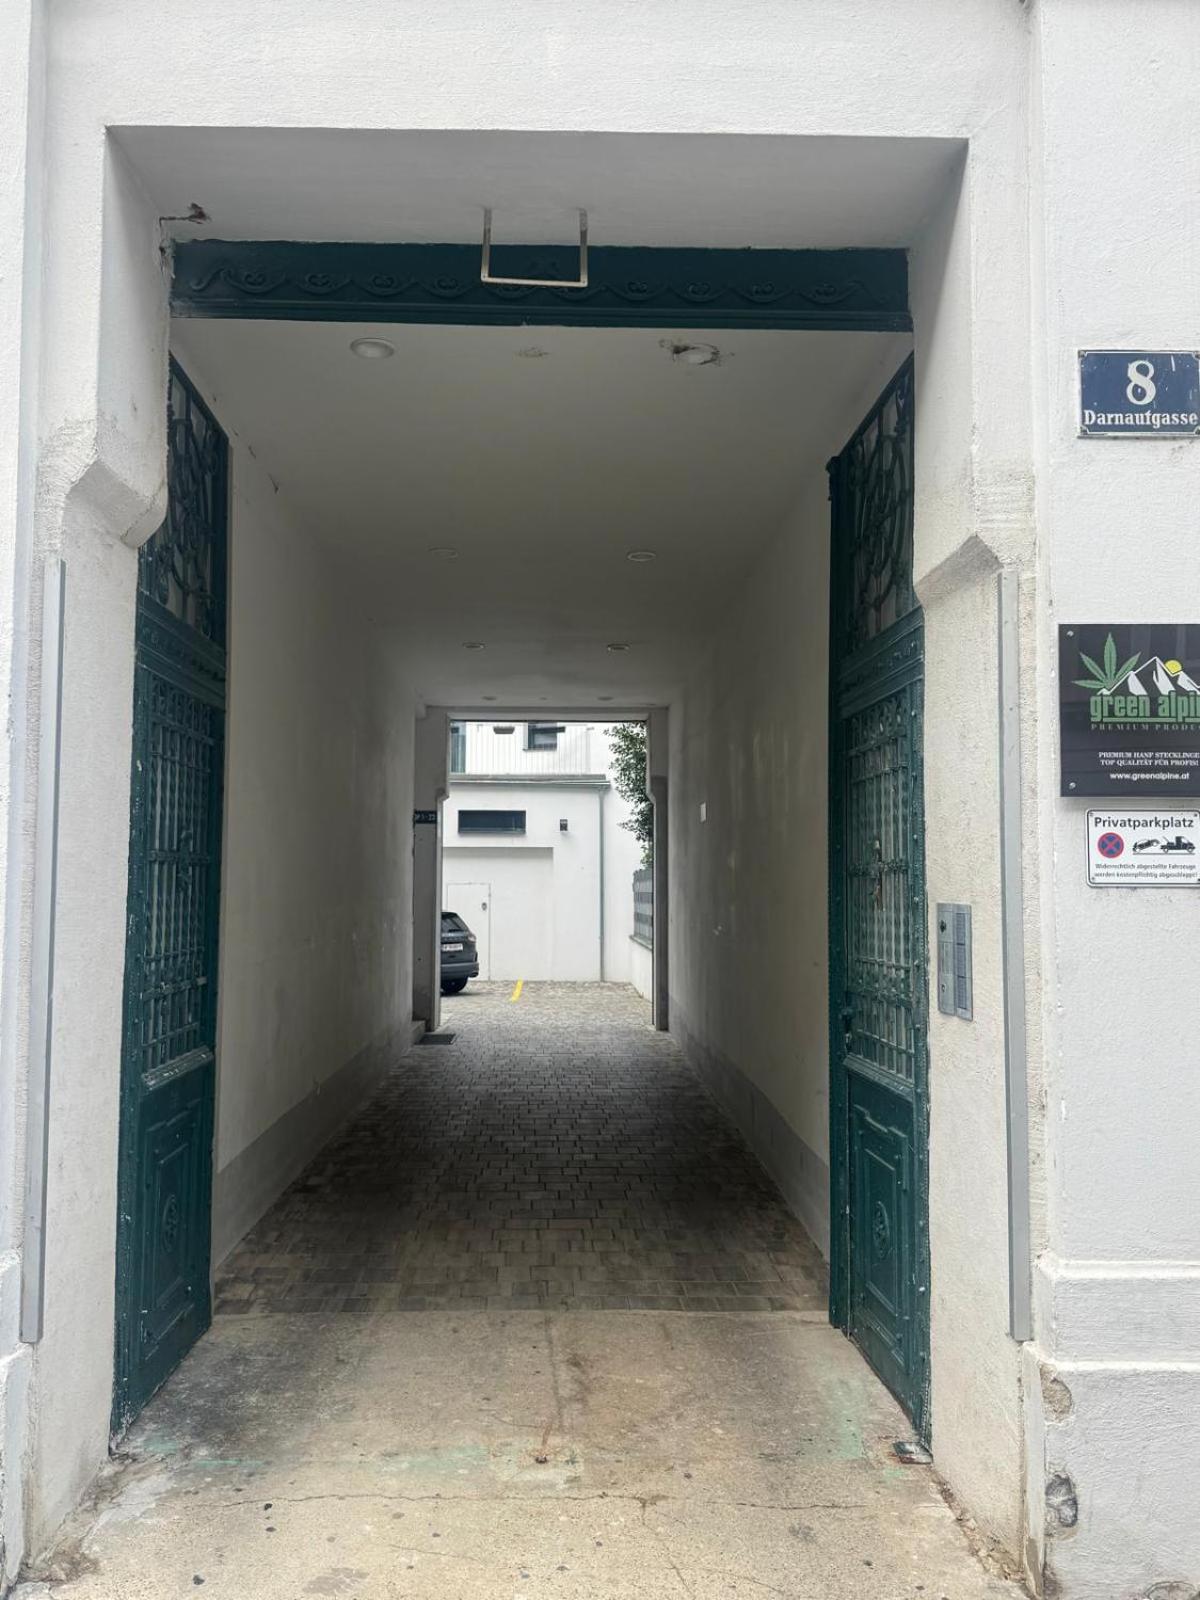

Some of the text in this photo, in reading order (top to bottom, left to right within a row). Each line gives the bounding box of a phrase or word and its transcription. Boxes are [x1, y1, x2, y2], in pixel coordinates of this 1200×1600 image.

[1126, 360, 1156, 405] 8
[1090, 690, 1200, 722] green alpi
[1116, 758, 1153, 767] QUALITÄT
[1154, 758, 1169, 766] FÜR
[1109, 772, 1190, 781] www.greenalpine.at
[1094, 816, 1195, 830] Privatparkplatz
